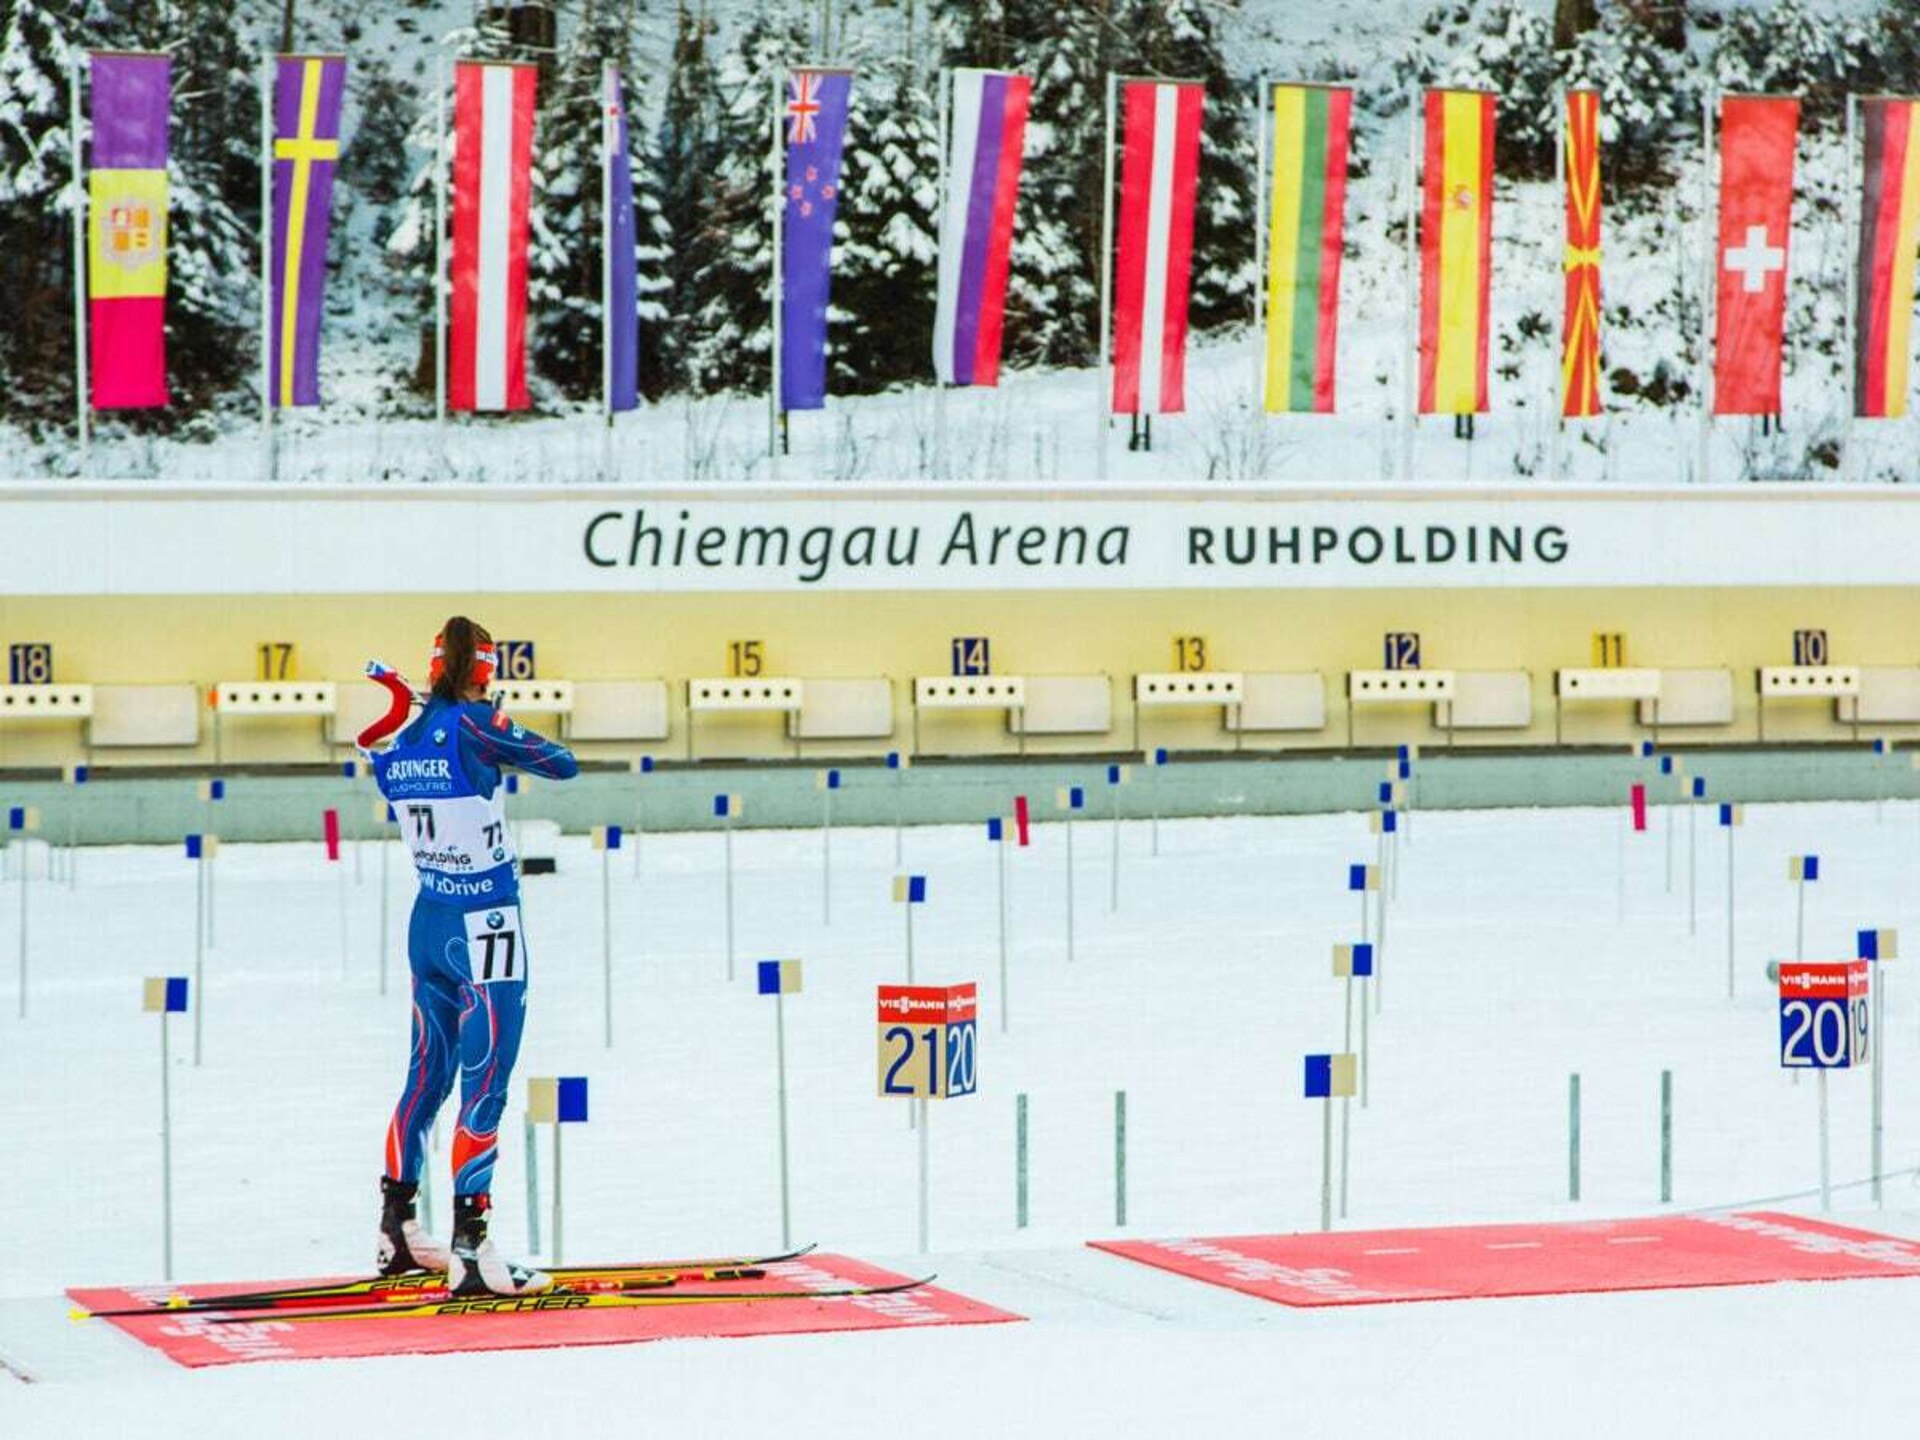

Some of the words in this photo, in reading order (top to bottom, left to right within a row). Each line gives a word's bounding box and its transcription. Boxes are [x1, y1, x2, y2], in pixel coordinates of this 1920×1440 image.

[582, 509, 921, 582] Chiemgau
[939, 512, 1131, 566] Arena
[1187, 525, 1571, 565] RUHPOLDING
[15, 645, 49, 681] 18
[259, 643, 294, 681] 17
[496, 641, 531, 681] 16
[732, 641, 761, 677] 15
[953, 639, 986, 676] 14
[1177, 638, 1205, 672] 13
[1387, 634, 1418, 670] 12
[1597, 634, 1620, 668] 11
[1794, 630, 1826, 666] 10
[407, 804, 435, 840] 77
[482, 821, 503, 848] 77
[436, 877, 494, 896] xDrive
[476, 930, 515, 980] 77
[1783, 999, 1847, 1067] 20
[1851, 998, 1868, 1064] 19
[884, 1026, 937, 1095] 21
[948, 1023, 976, 1096] 20
[436, 1295, 590, 1316] FISCHER
